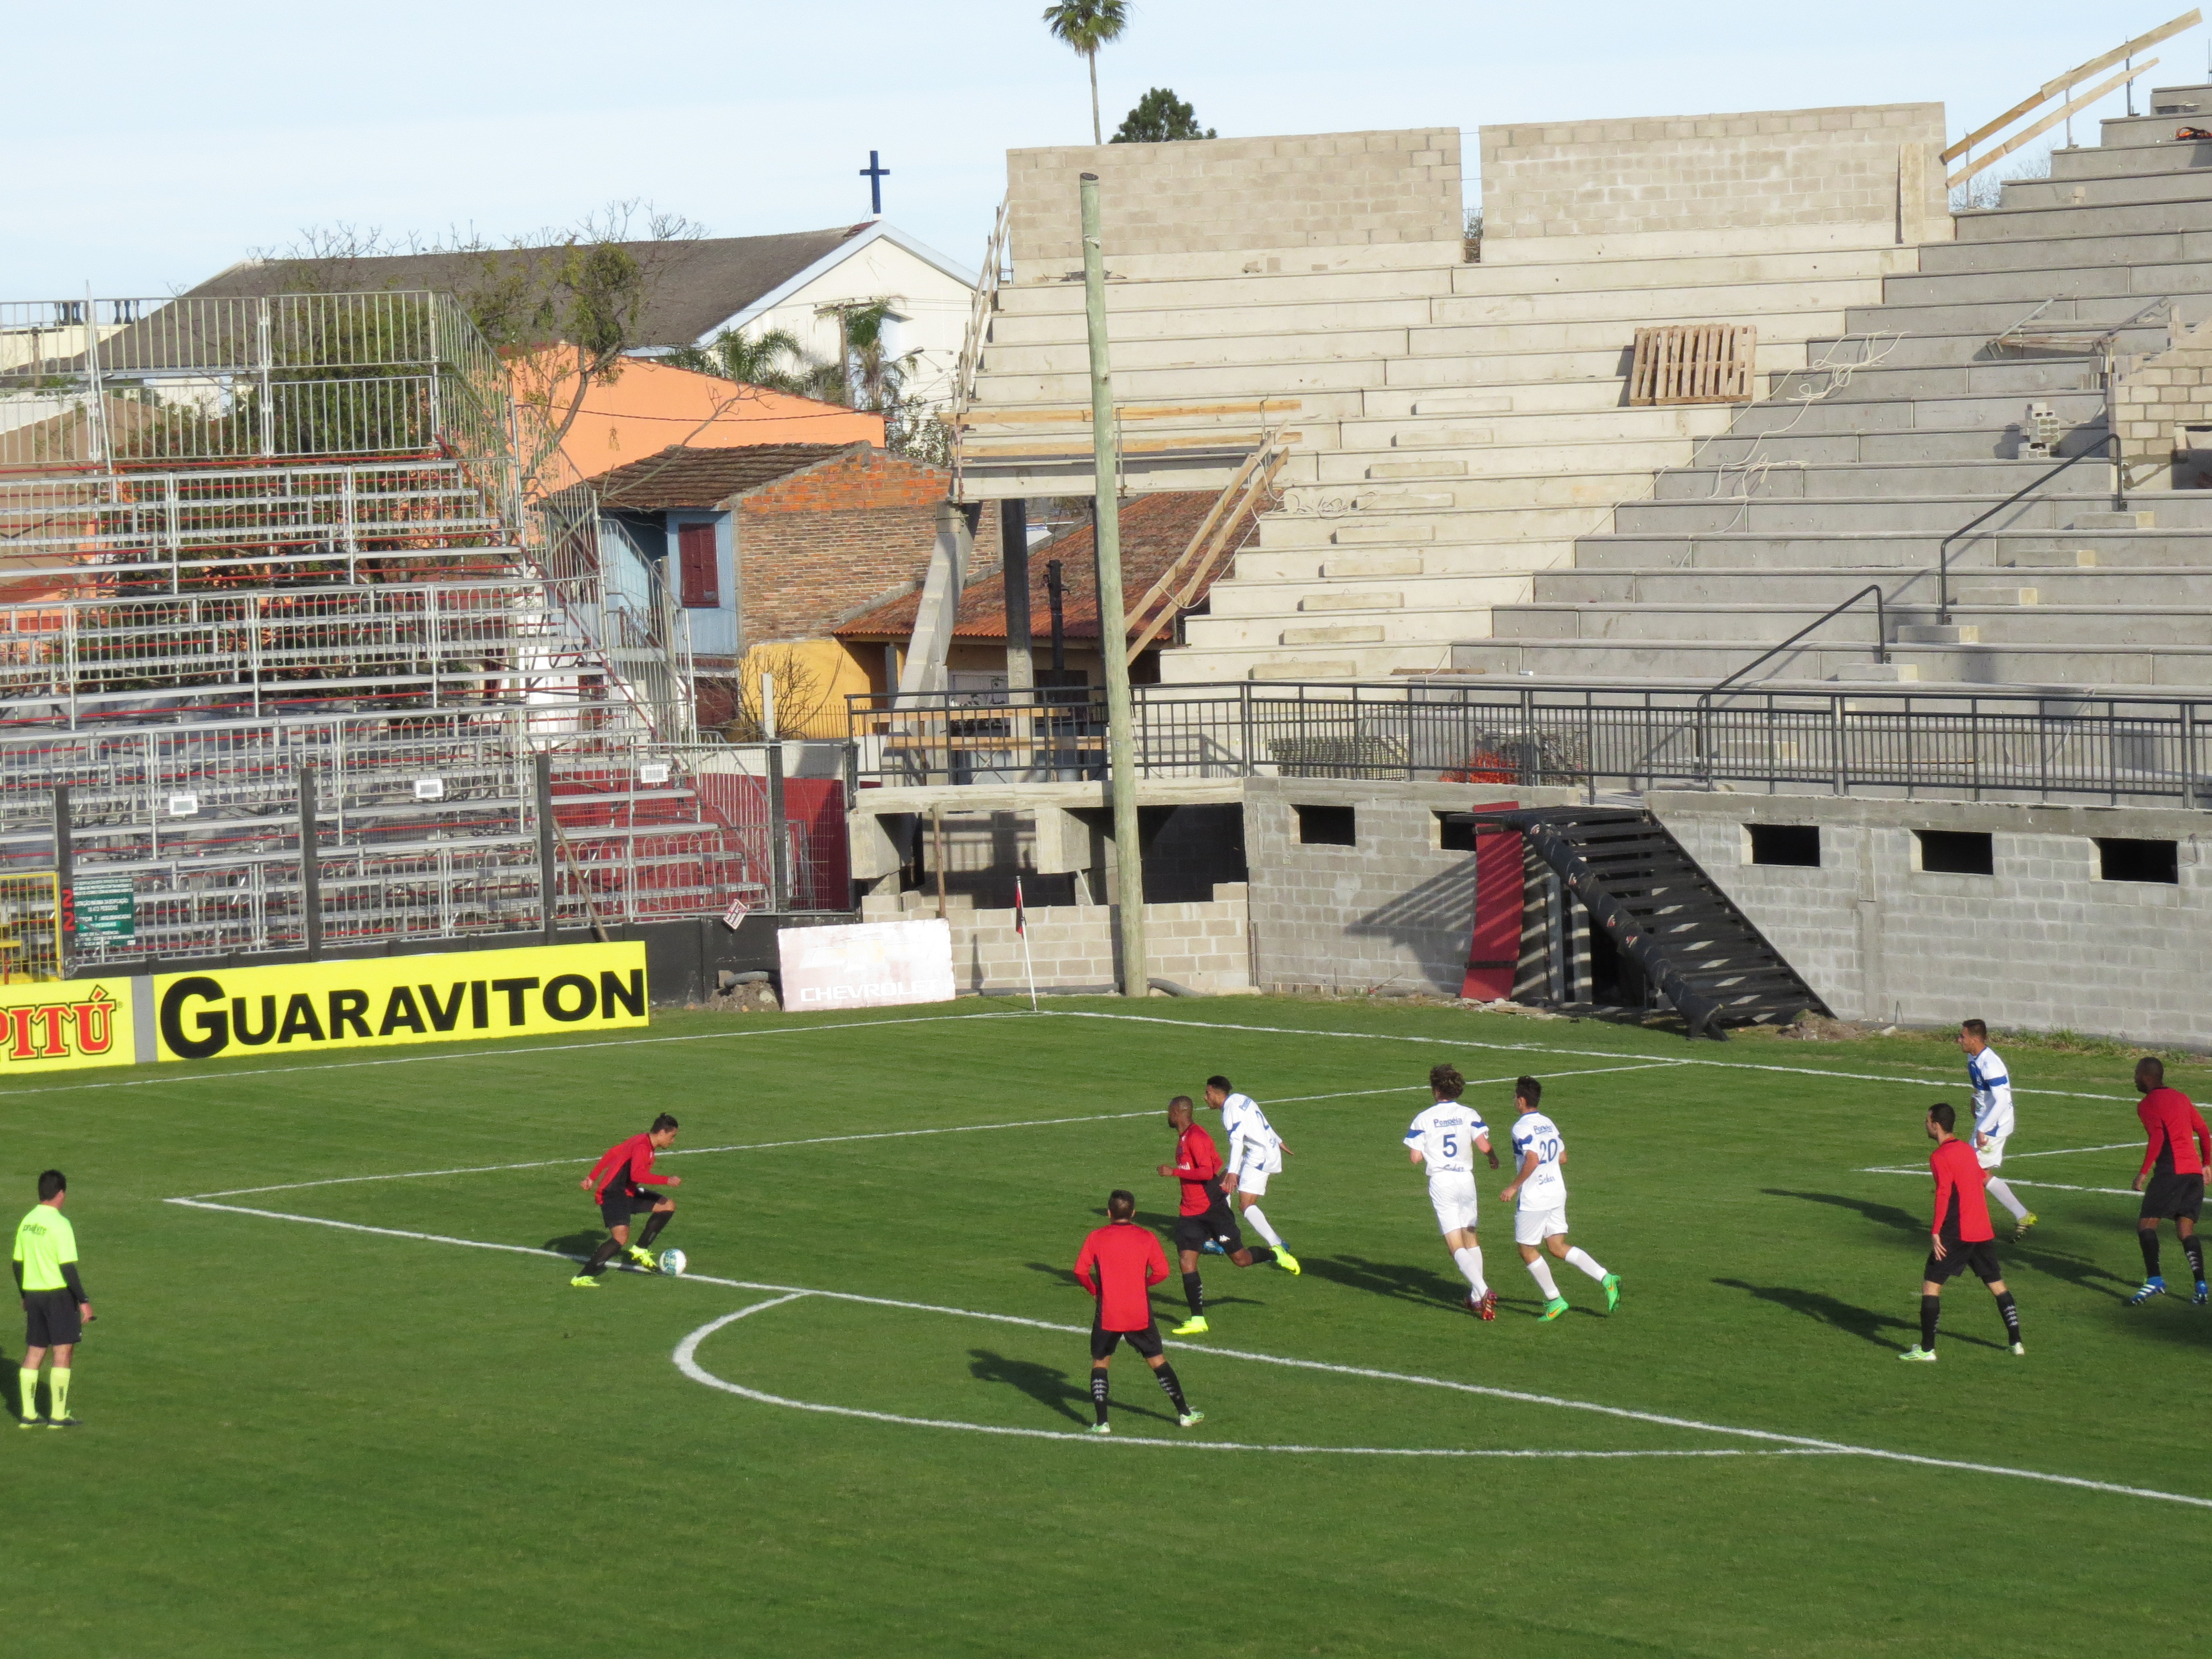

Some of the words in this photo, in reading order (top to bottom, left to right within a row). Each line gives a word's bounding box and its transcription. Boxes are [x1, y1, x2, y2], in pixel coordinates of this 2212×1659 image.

[801, 979, 939, 1002] CHEVROLET
[160, 969, 645, 1058] GUARAVITON
[1443, 1134, 1457, 1157] 5
[1539, 1139, 1558, 1164] 20
